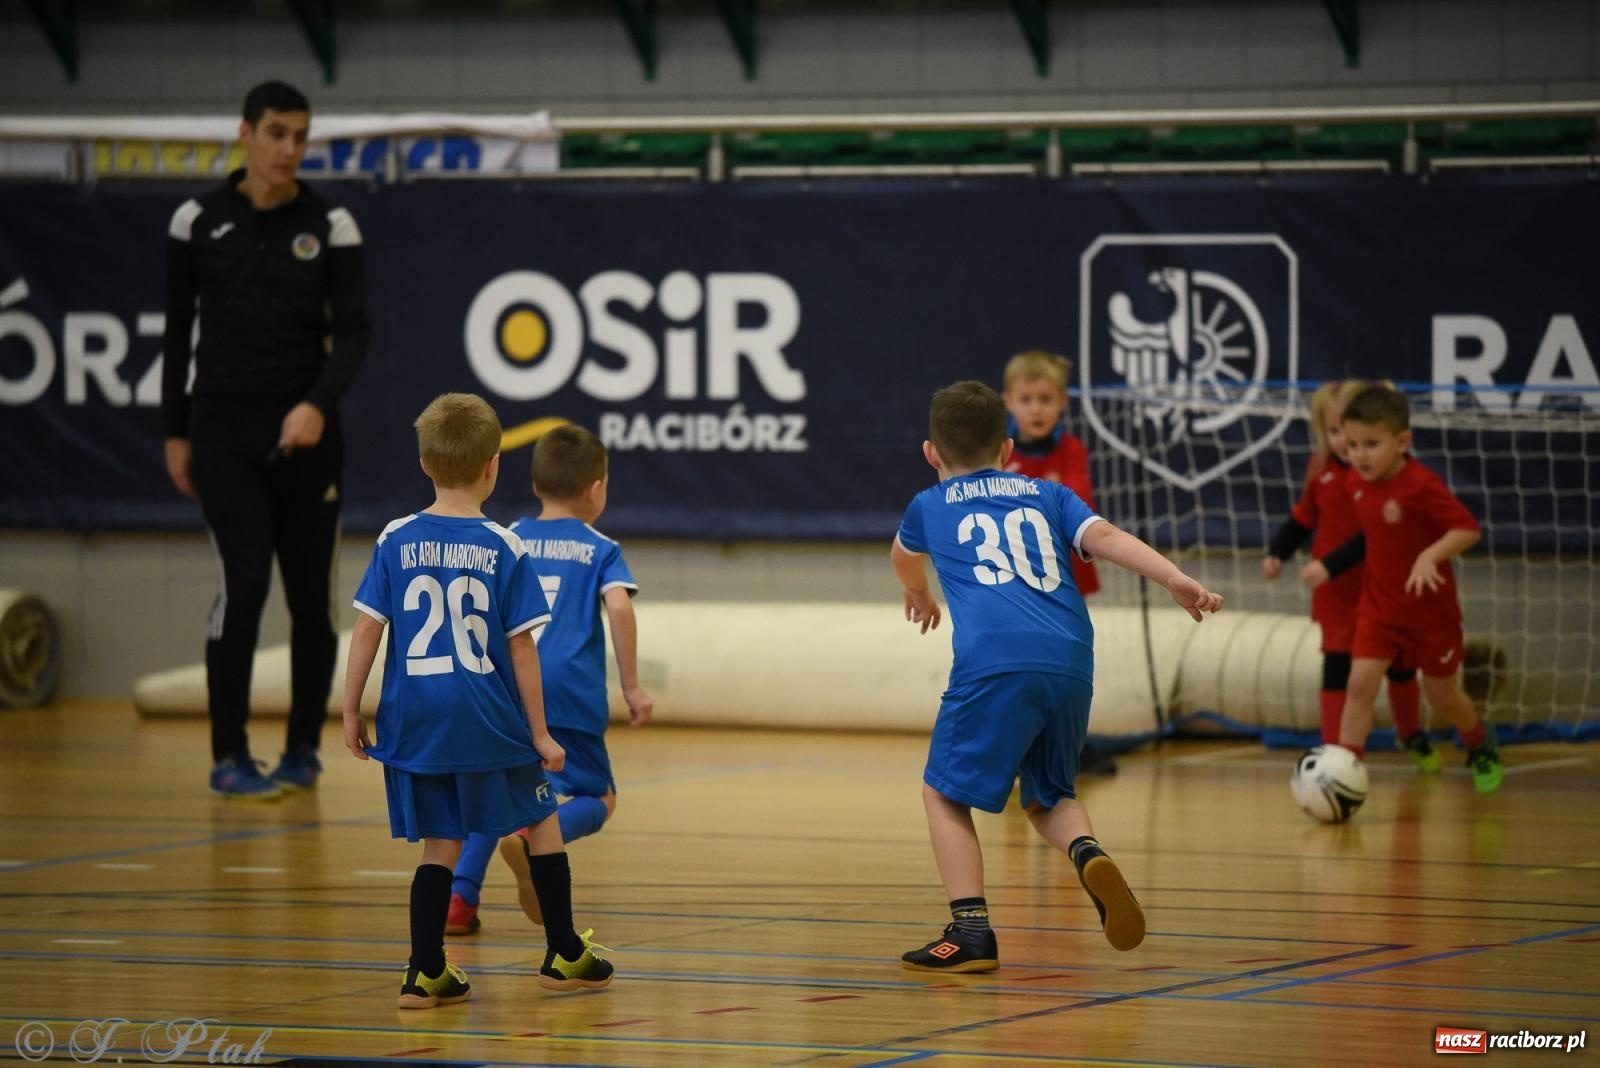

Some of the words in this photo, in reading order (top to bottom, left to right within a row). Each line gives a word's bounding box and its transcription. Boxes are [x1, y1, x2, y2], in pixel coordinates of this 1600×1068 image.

[599, 404, 807, 450] RACIBÓRZ
[945, 482, 963, 504] UKS
[963, 479, 988, 500] ARKA
[987, 477, 1040, 498] MARKOWICE
[400, 542, 416, 570] UKS
[419, 541, 440, 567] ARKA
[443, 543, 498, 575] MARKOWICE
[543, 540, 595, 565] MARKOWICE
[957, 507, 1061, 592] 30
[403, 575, 495, 676] 26
